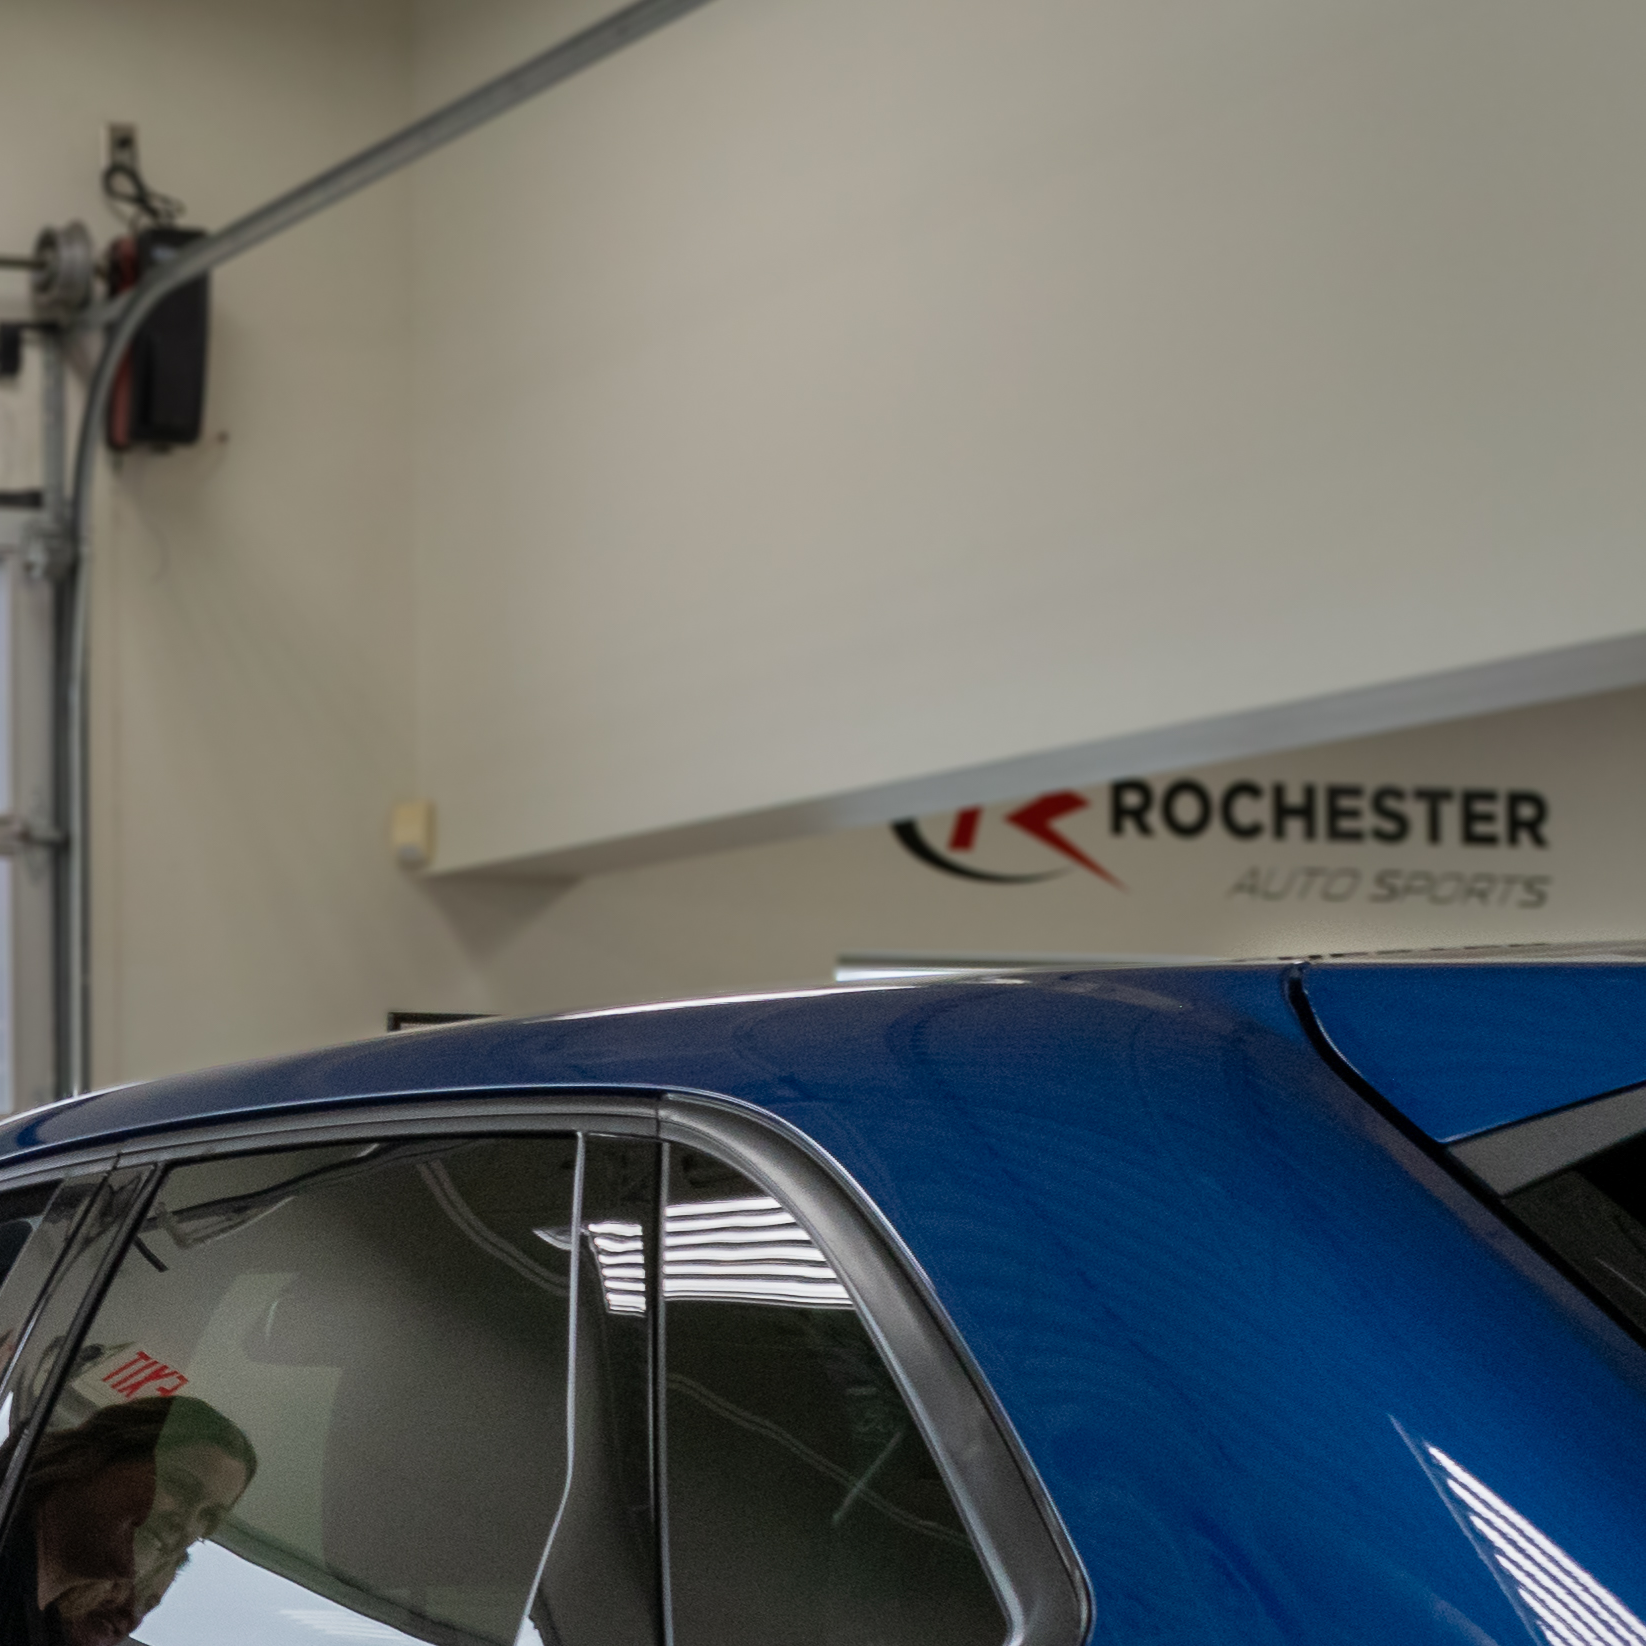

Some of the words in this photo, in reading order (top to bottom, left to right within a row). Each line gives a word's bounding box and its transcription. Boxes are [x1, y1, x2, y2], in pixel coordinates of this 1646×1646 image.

[1109, 779, 1550, 848] ROCHESTER
[1226, 865, 1362, 902] AUTO
[1368, 868, 1553, 909] SPORTS
